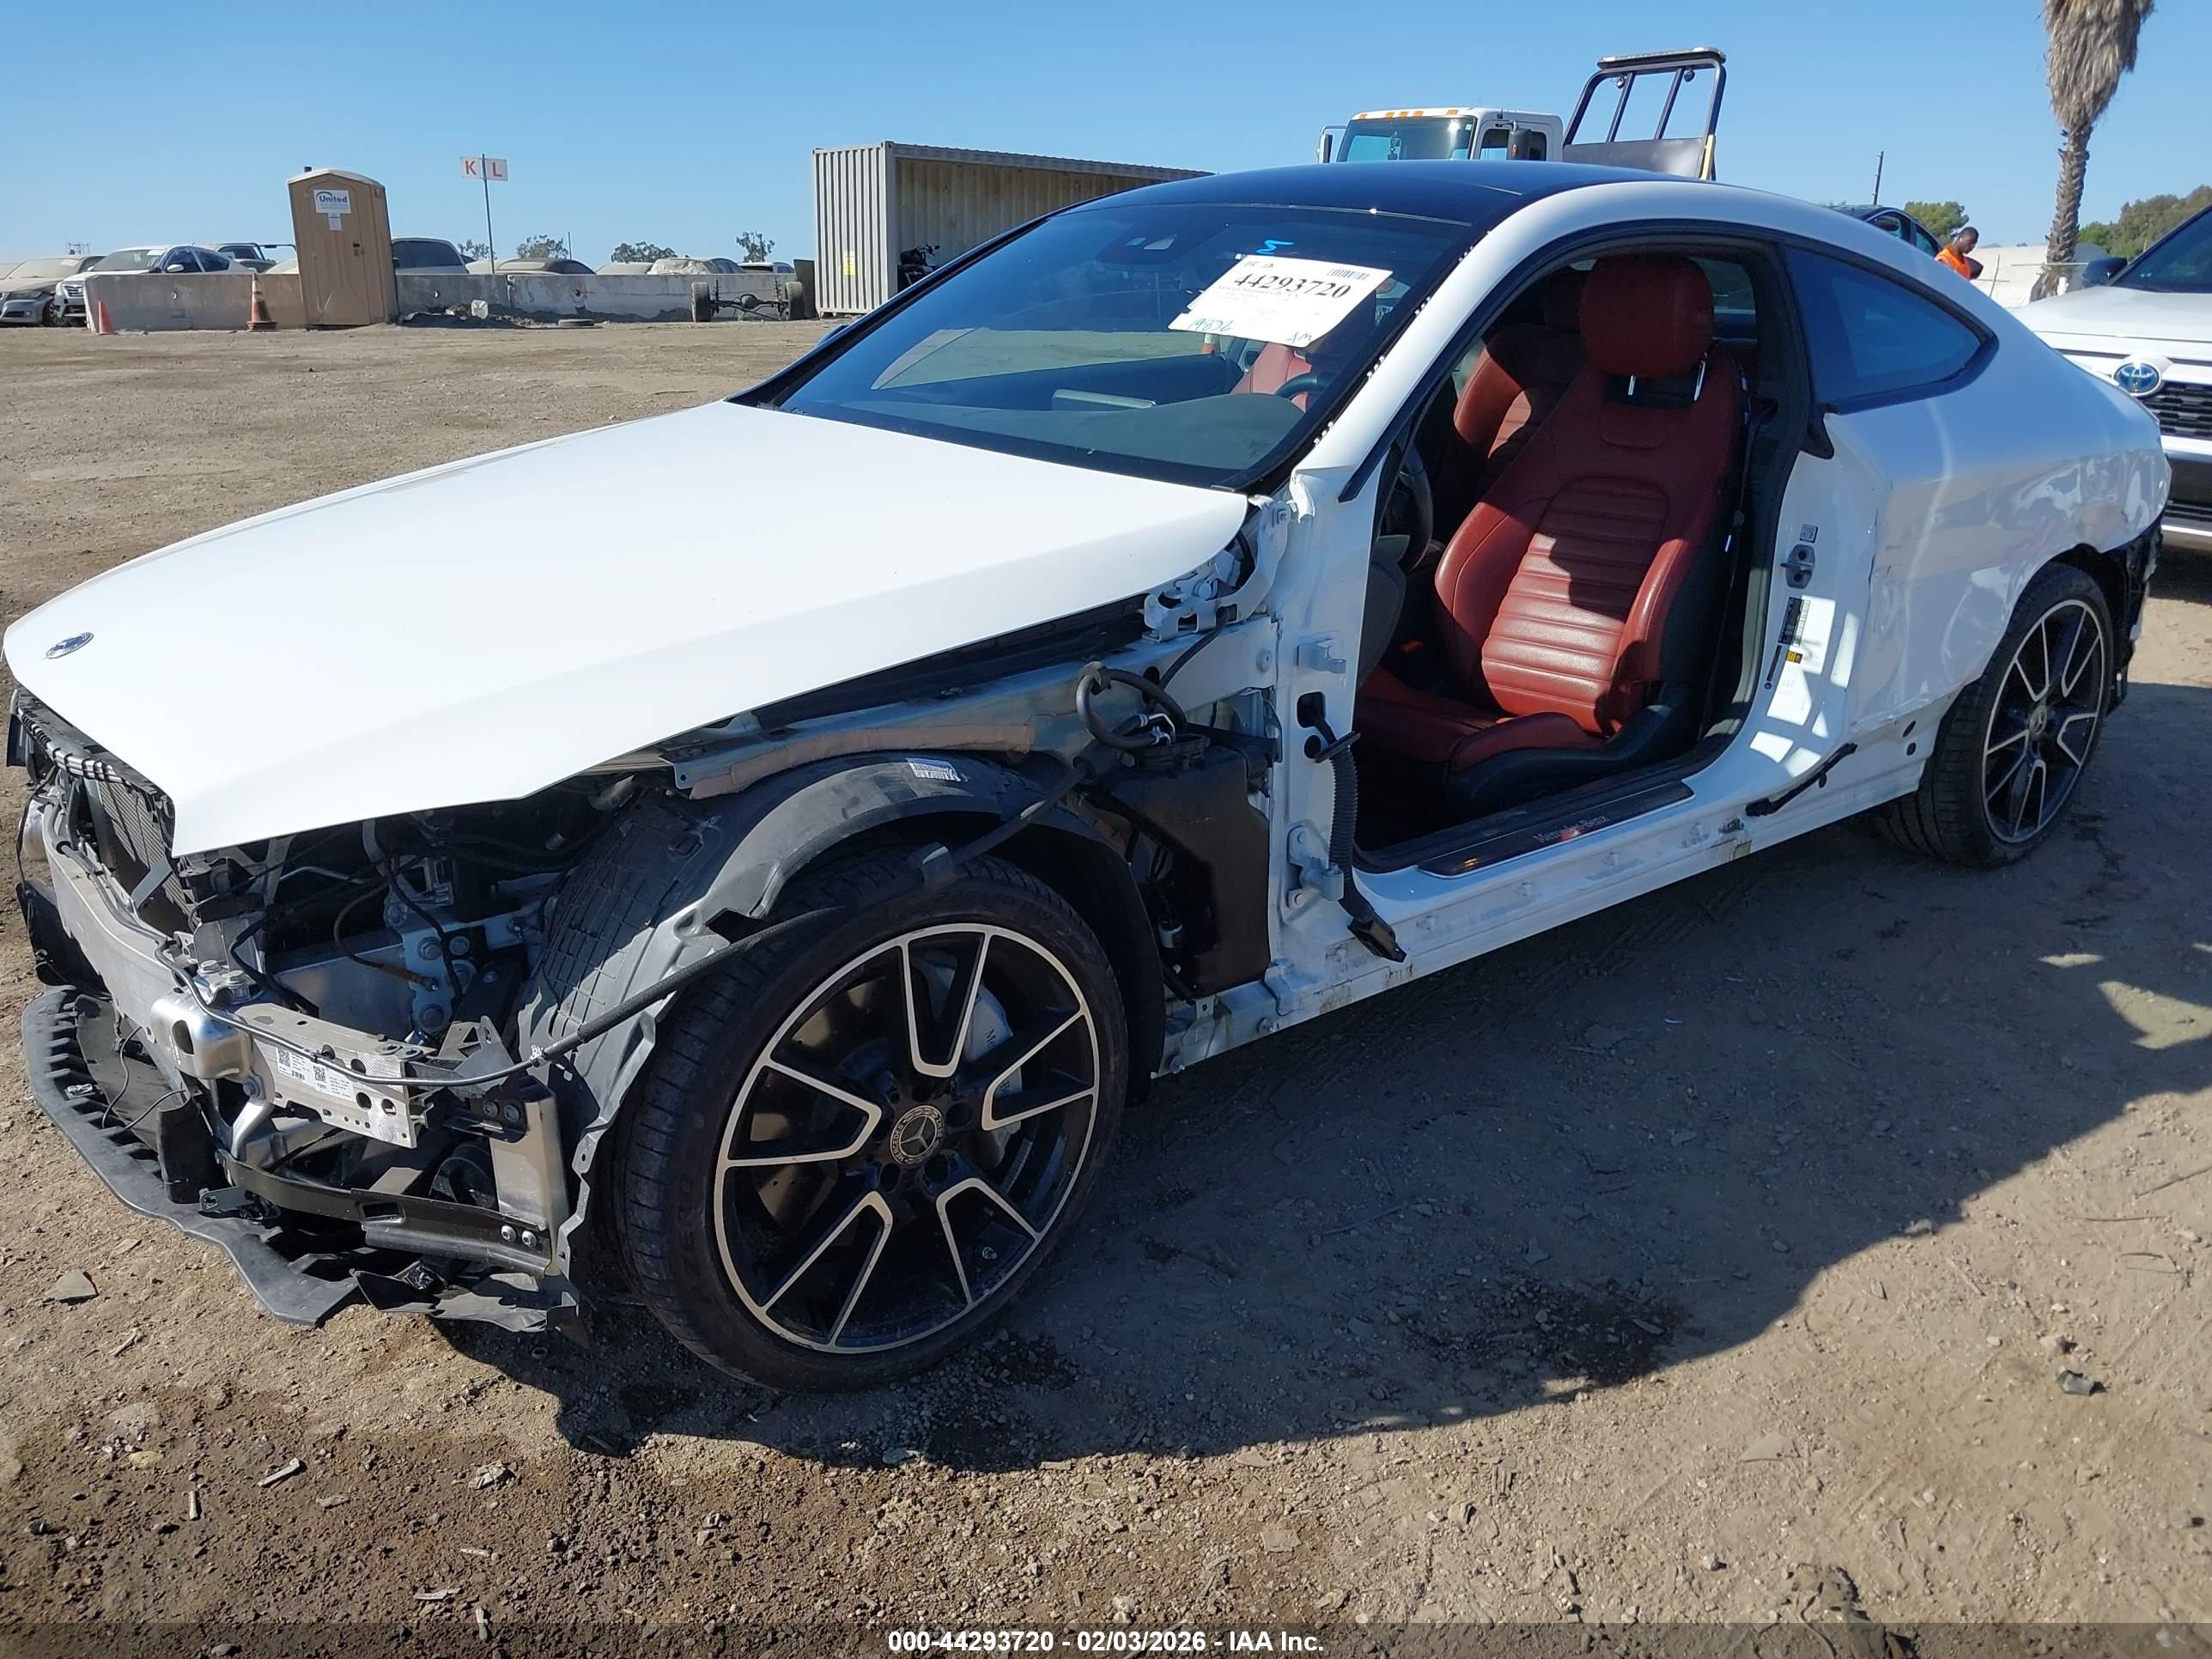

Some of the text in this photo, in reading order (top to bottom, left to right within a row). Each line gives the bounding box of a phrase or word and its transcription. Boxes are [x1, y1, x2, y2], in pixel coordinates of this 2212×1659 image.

[465, 160, 477, 175] K
[492, 161, 502, 177] L
[319, 194, 348, 204] United
[1234, 273, 1352, 299] 44293720
[892, 1123, 905, 1163] MERCEDES
